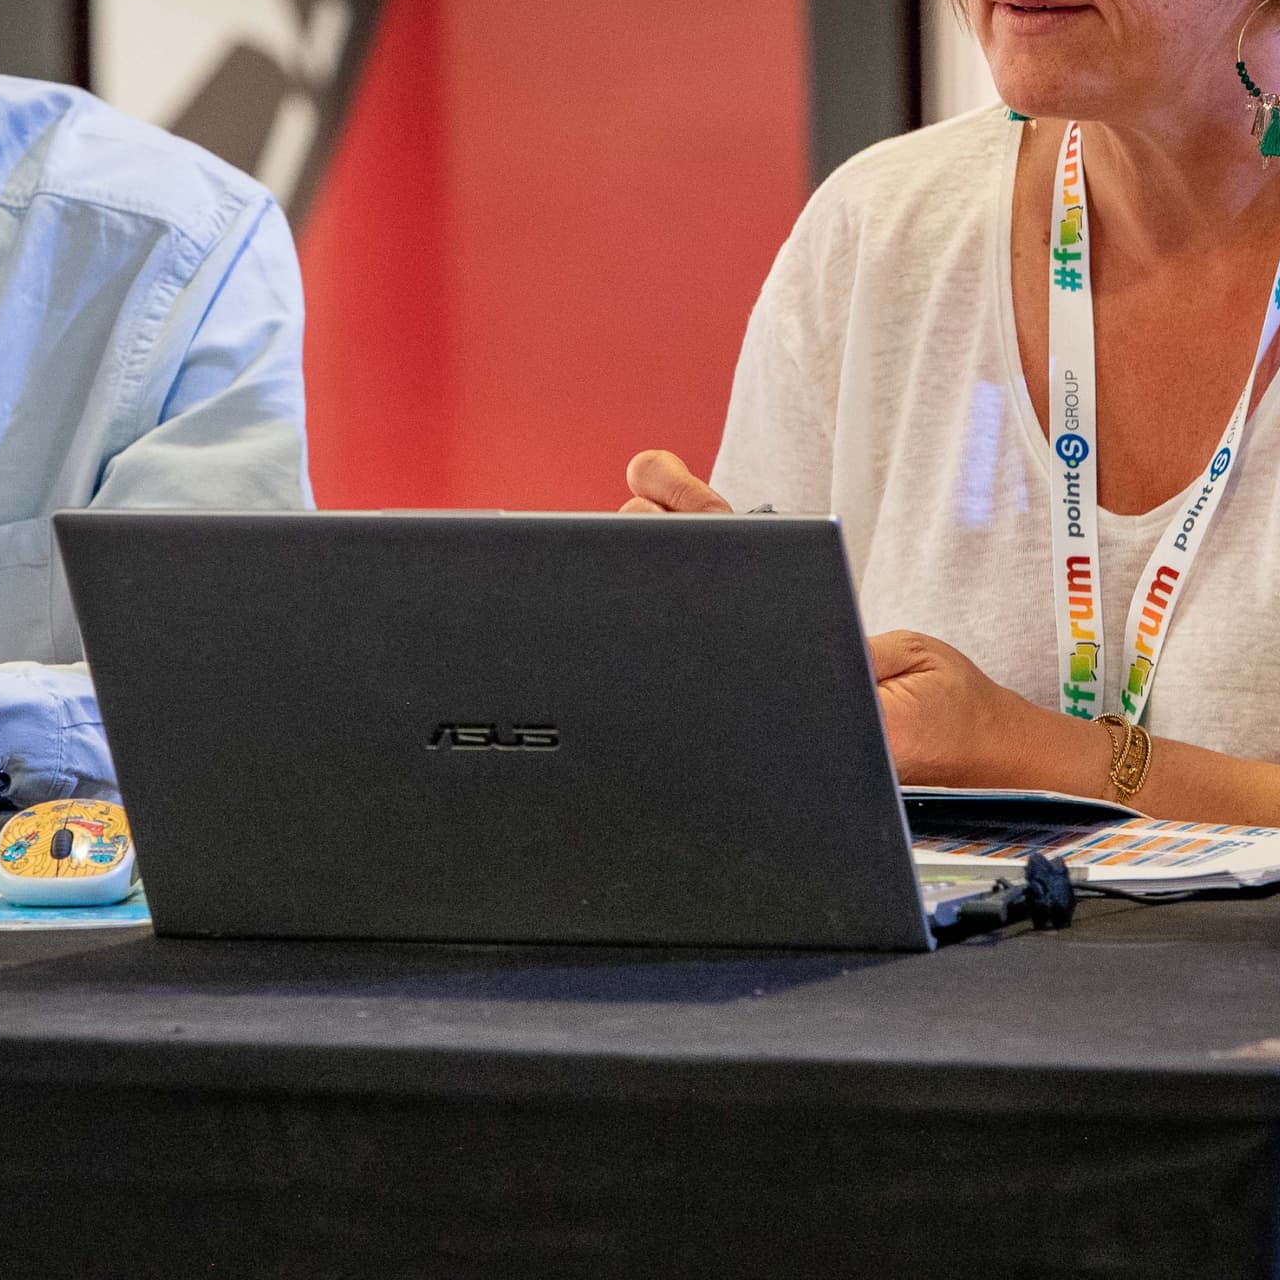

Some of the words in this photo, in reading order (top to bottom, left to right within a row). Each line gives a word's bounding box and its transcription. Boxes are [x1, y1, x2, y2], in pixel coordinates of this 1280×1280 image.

[1064, 370, 1080, 431] GROUP
[1063, 472, 1085, 538] point
[1173, 484, 1214, 553] point
[425, 723, 561, 751] ASUS
